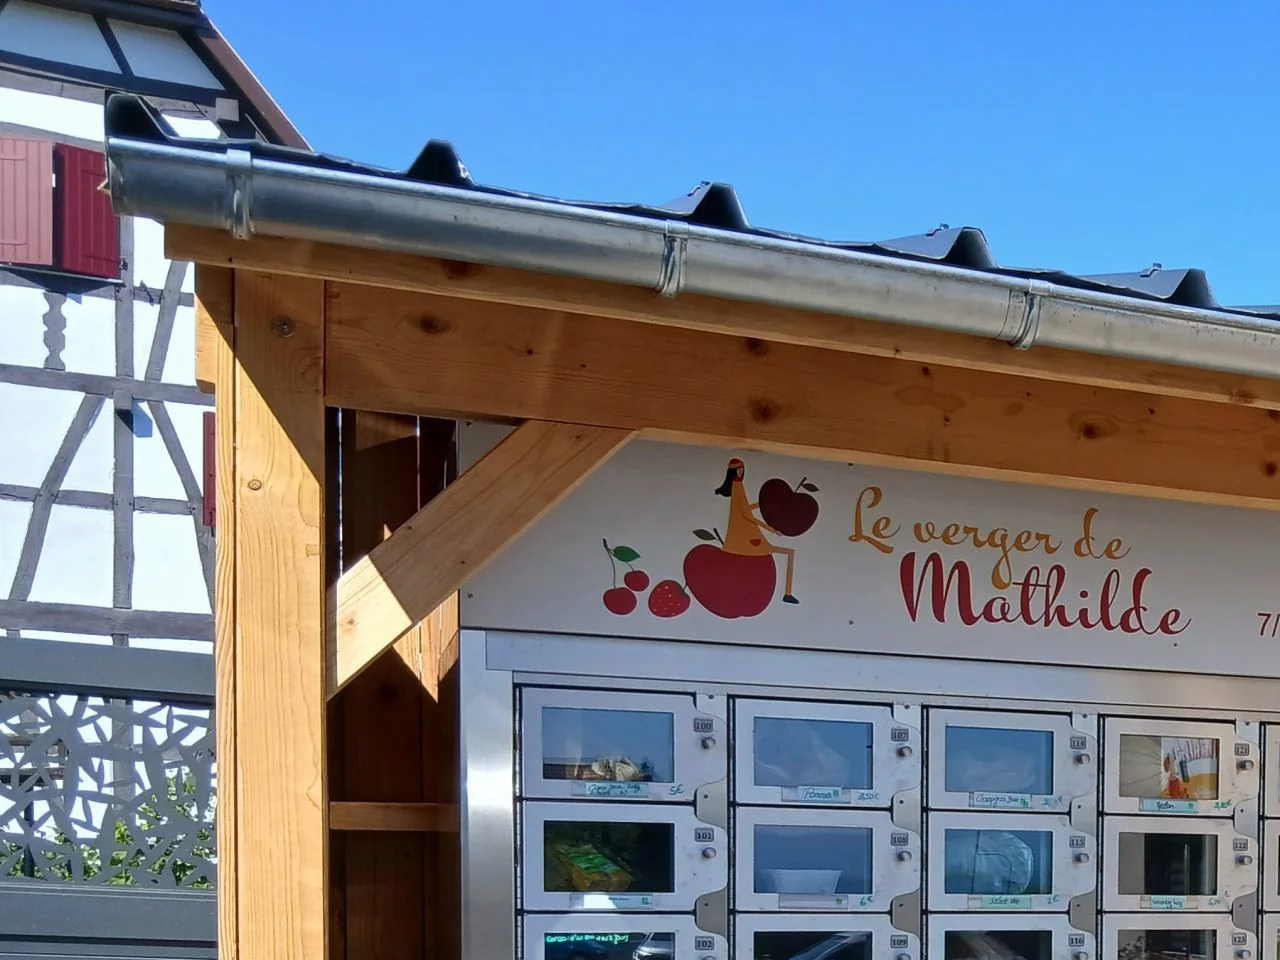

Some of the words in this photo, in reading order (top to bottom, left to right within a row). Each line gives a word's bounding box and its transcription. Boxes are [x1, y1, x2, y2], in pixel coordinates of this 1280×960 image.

[848, 486, 900, 554] Le
[911, 519, 1062, 591] verger
[1073, 507, 1132, 561] de
[900, 551, 1192, 638] Mathilde
[695, 721, 712, 730] 100
[893, 731, 908, 740] 107
[1235, 746, 1249, 755] 121
[696, 831, 712, 840] 101
[892, 835, 908, 844] 108
[1070, 838, 1085, 847] 115
[1233, 841, 1248, 850] 122
[891, 938, 907, 947] 109
[1069, 936, 1084, 945] 116
[1232, 935, 1246, 944] 123
[696, 940, 713, 949] 102
